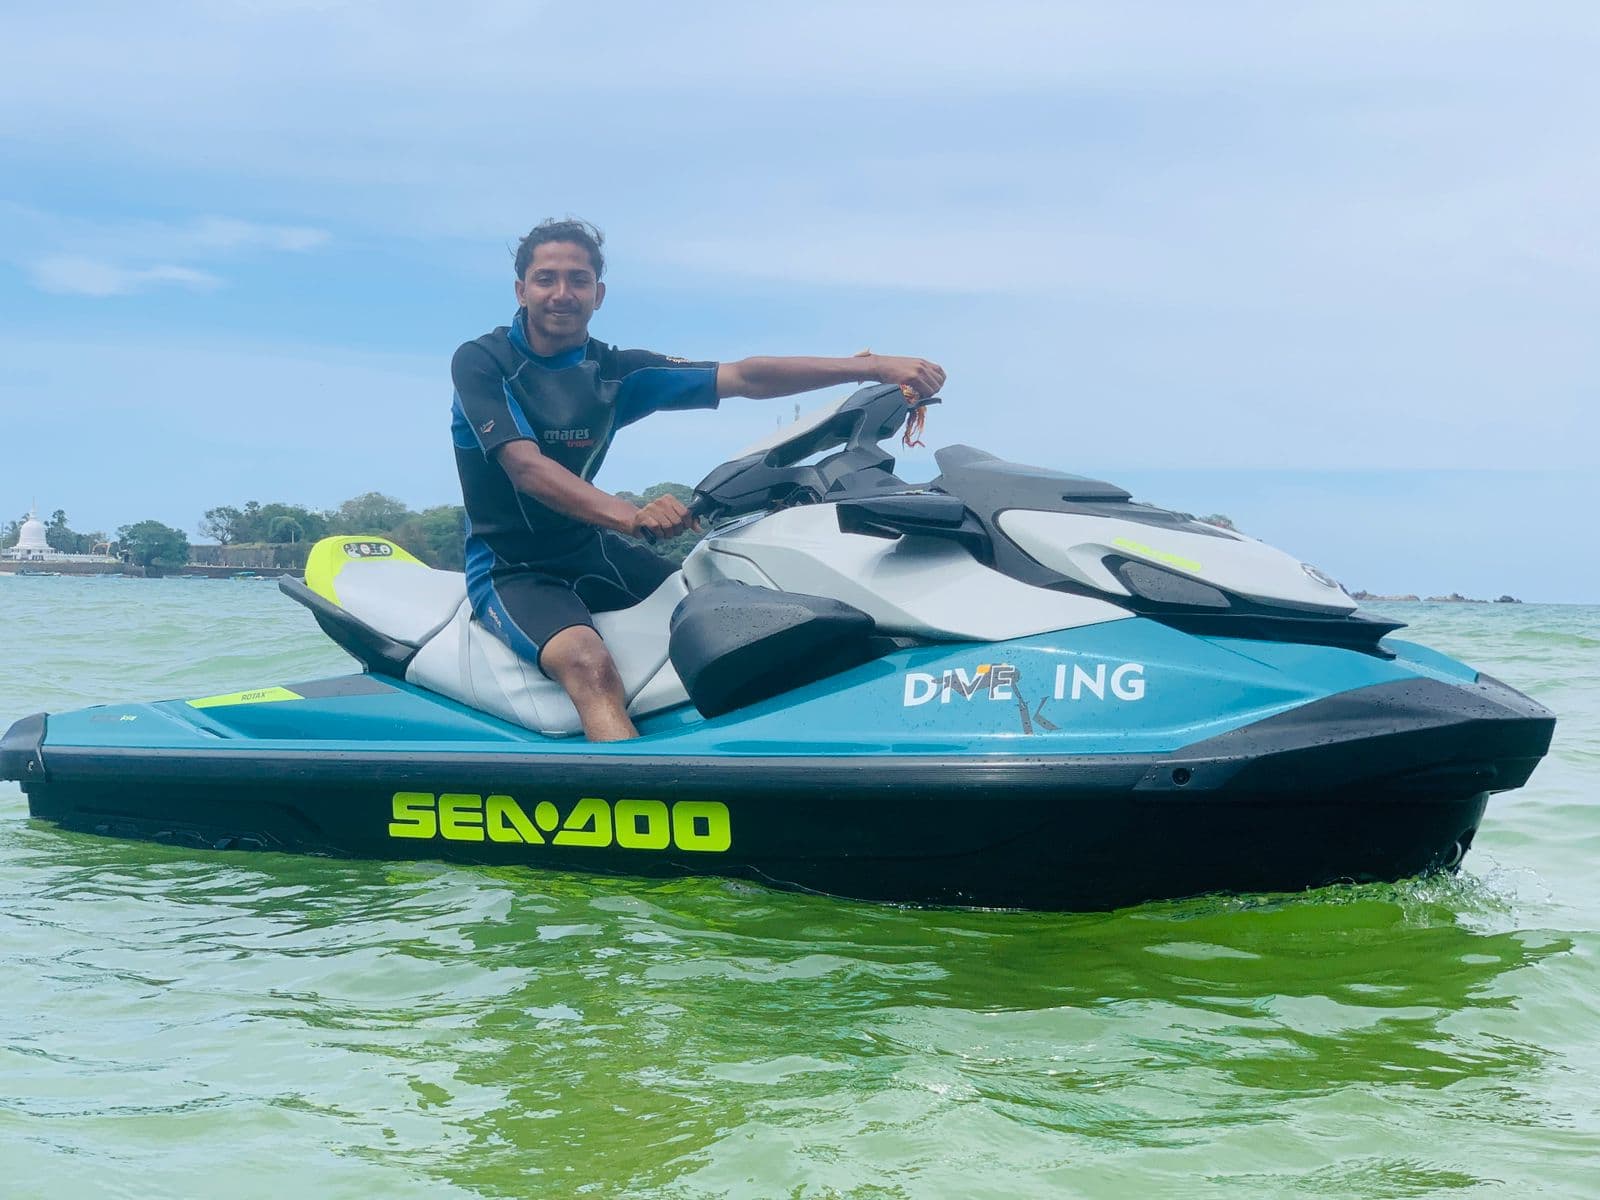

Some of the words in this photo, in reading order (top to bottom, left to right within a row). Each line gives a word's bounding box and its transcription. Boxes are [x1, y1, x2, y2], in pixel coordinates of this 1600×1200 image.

[543, 428, 590, 444] mares
[903, 664, 1016, 707] DIVE
[240, 691, 266, 701] ROTAX
